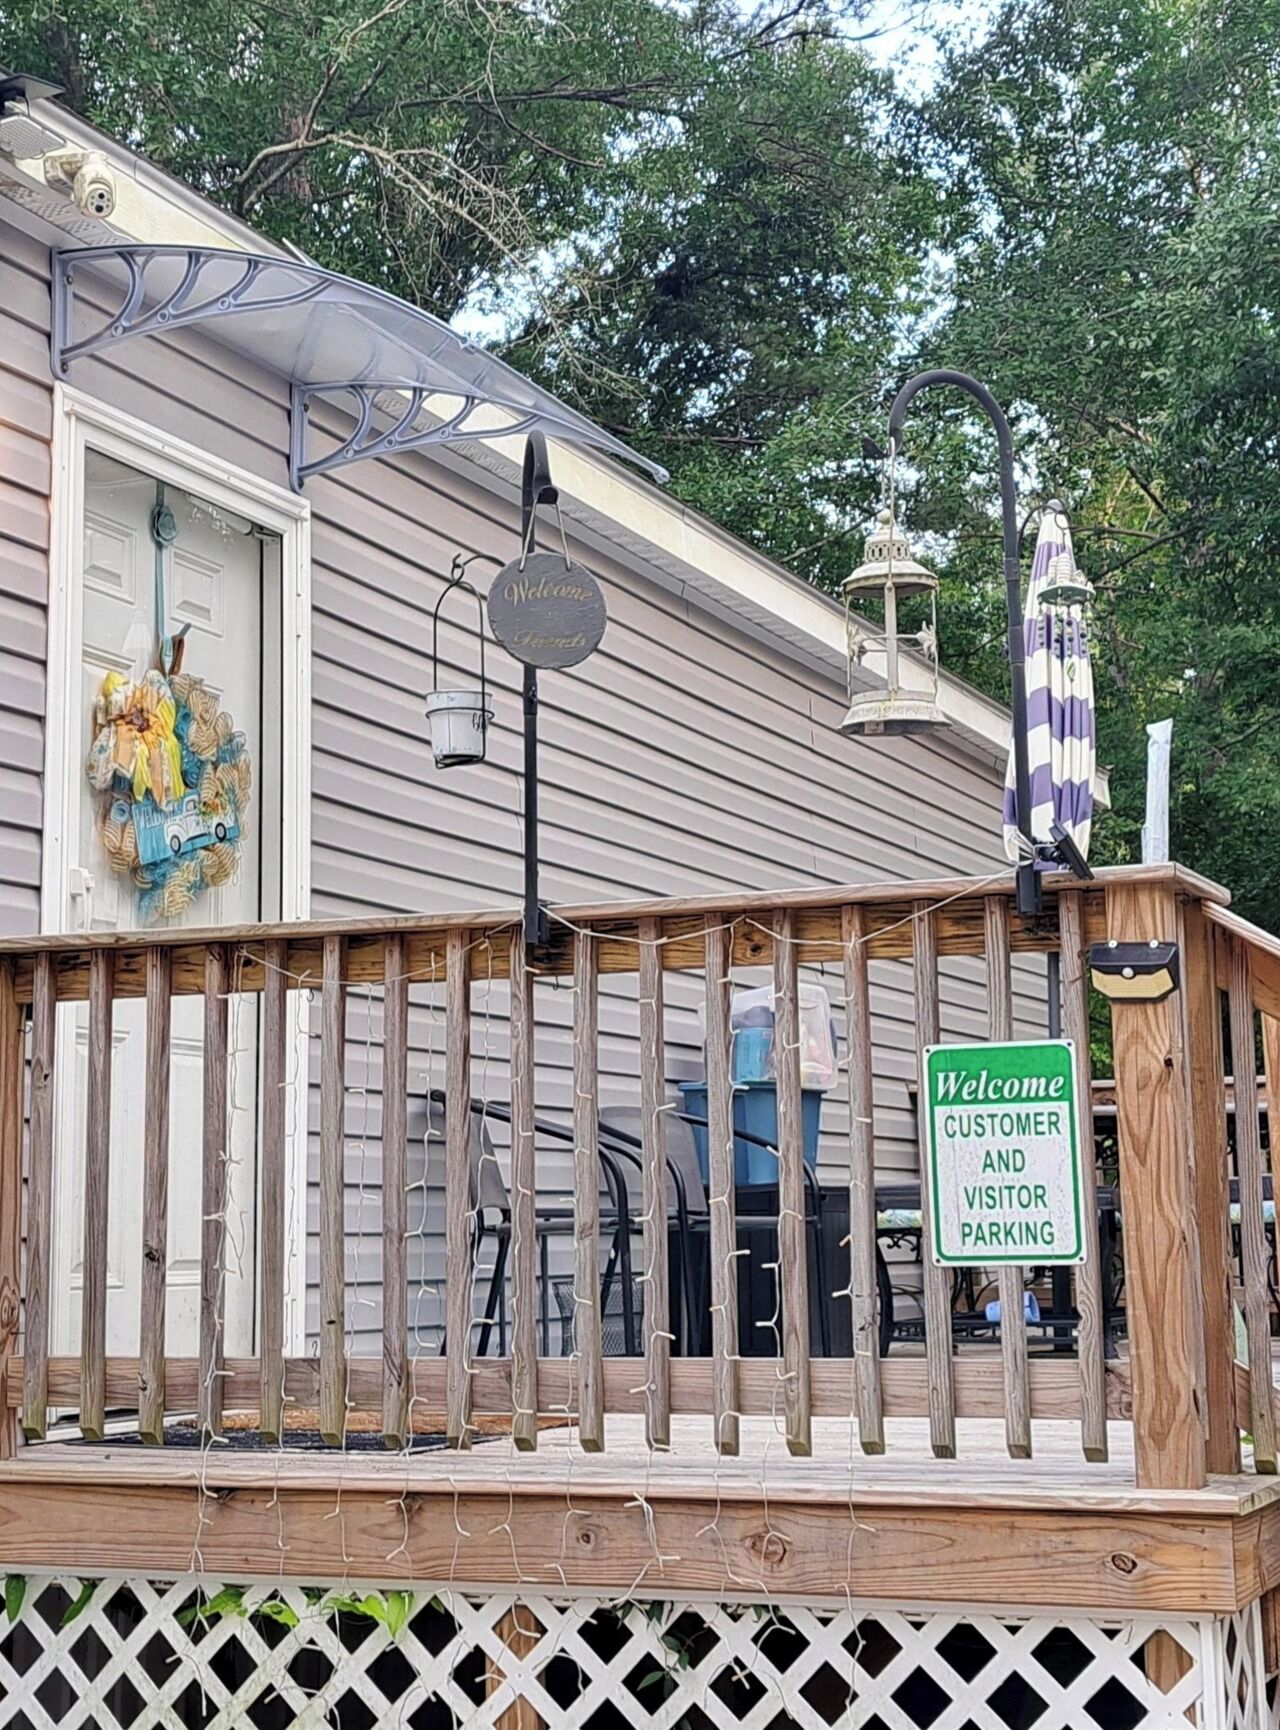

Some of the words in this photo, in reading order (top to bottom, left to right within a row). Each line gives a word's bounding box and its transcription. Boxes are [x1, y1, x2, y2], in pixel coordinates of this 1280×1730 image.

[504, 577, 593, 607] Welcome
[936, 1070, 1065, 1101] Welcome
[944, 1112, 1062, 1138] CUSTOMER
[982, 1149, 1026, 1173] AND
[964, 1184, 1048, 1210] VISITOR
[961, 1220, 1055, 1247] PARKING
